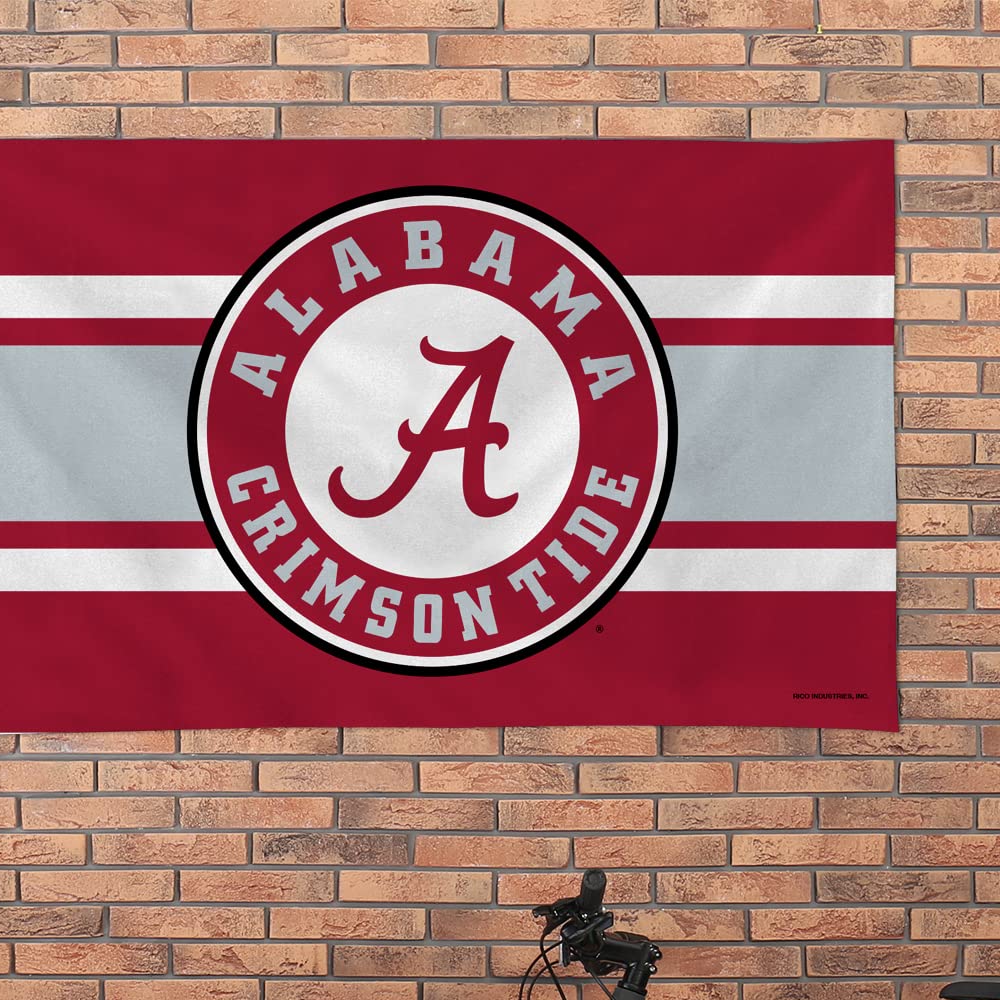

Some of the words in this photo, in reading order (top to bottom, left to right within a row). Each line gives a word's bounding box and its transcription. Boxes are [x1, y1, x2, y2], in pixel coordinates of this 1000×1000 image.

[230, 220, 635, 400] ALABAMA
[328, 335, 519, 518] A
[227, 465, 498, 643] CRIMSON
[507, 466, 639, 612] TIDE
